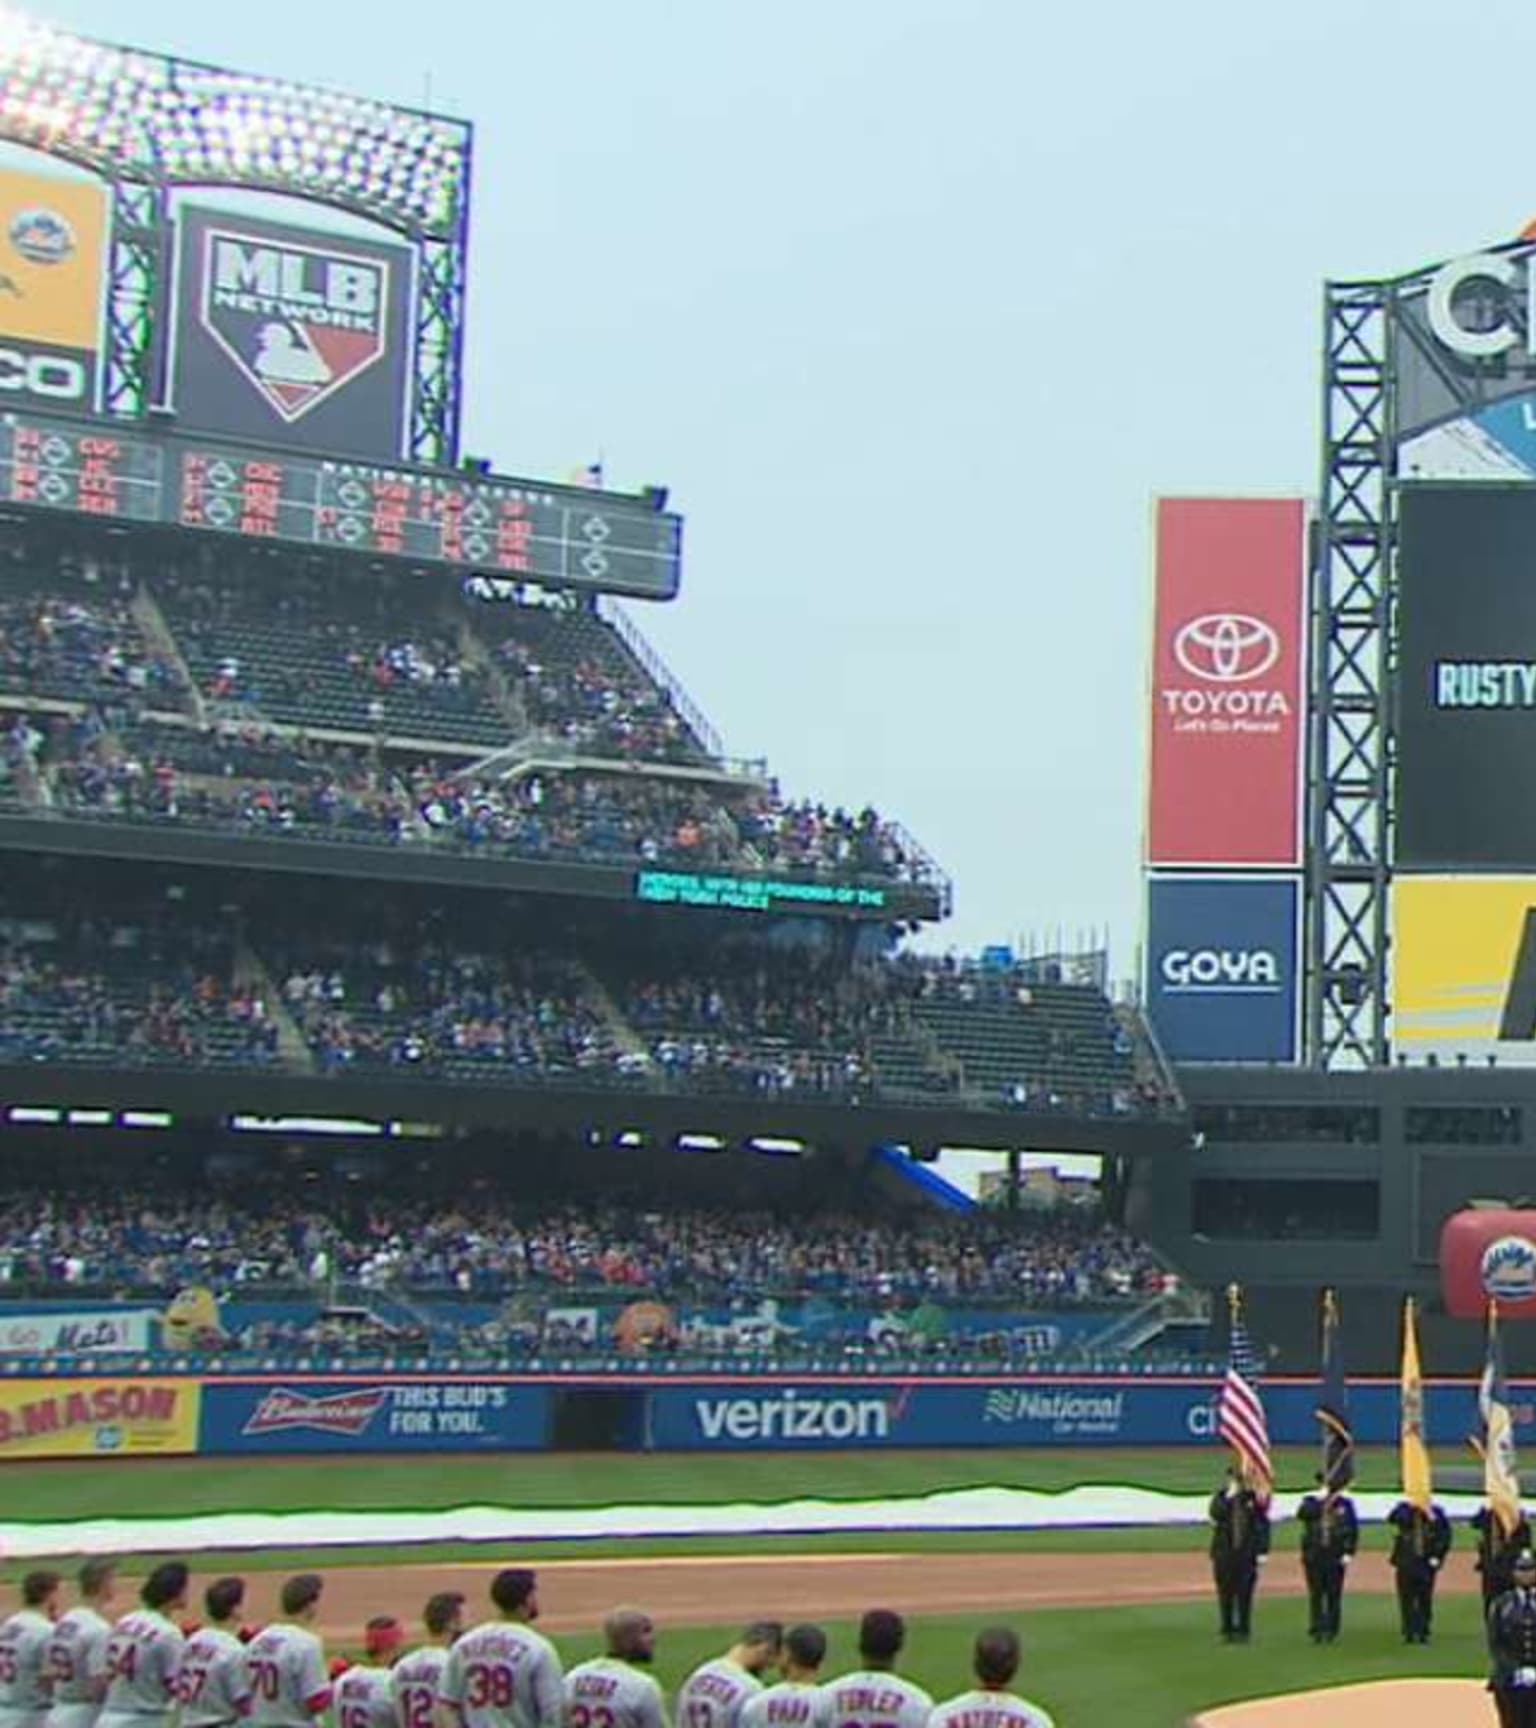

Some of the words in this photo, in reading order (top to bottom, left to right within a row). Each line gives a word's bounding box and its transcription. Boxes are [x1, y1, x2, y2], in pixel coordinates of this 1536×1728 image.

[214, 240, 377, 311] MLB
[214, 290, 375, 333] NETWORK
[1162, 690, 1290, 715] TOYOTA
[1438, 663, 1536, 707] RUSTY
[1162, 951, 1279, 983] GOYA
[391, 1386, 438, 1407] THIS
[444, 1386, 507, 1408] BUD'S
[697, 1388, 888, 1438] verizon
[1017, 1393, 1122, 1419] National
[390, 1411, 431, 1433] FOR
[437, 1411, 485, 1433] YOU.
[464, 1663, 513, 1709] 38
[402, 1688, 433, 1728] 12
